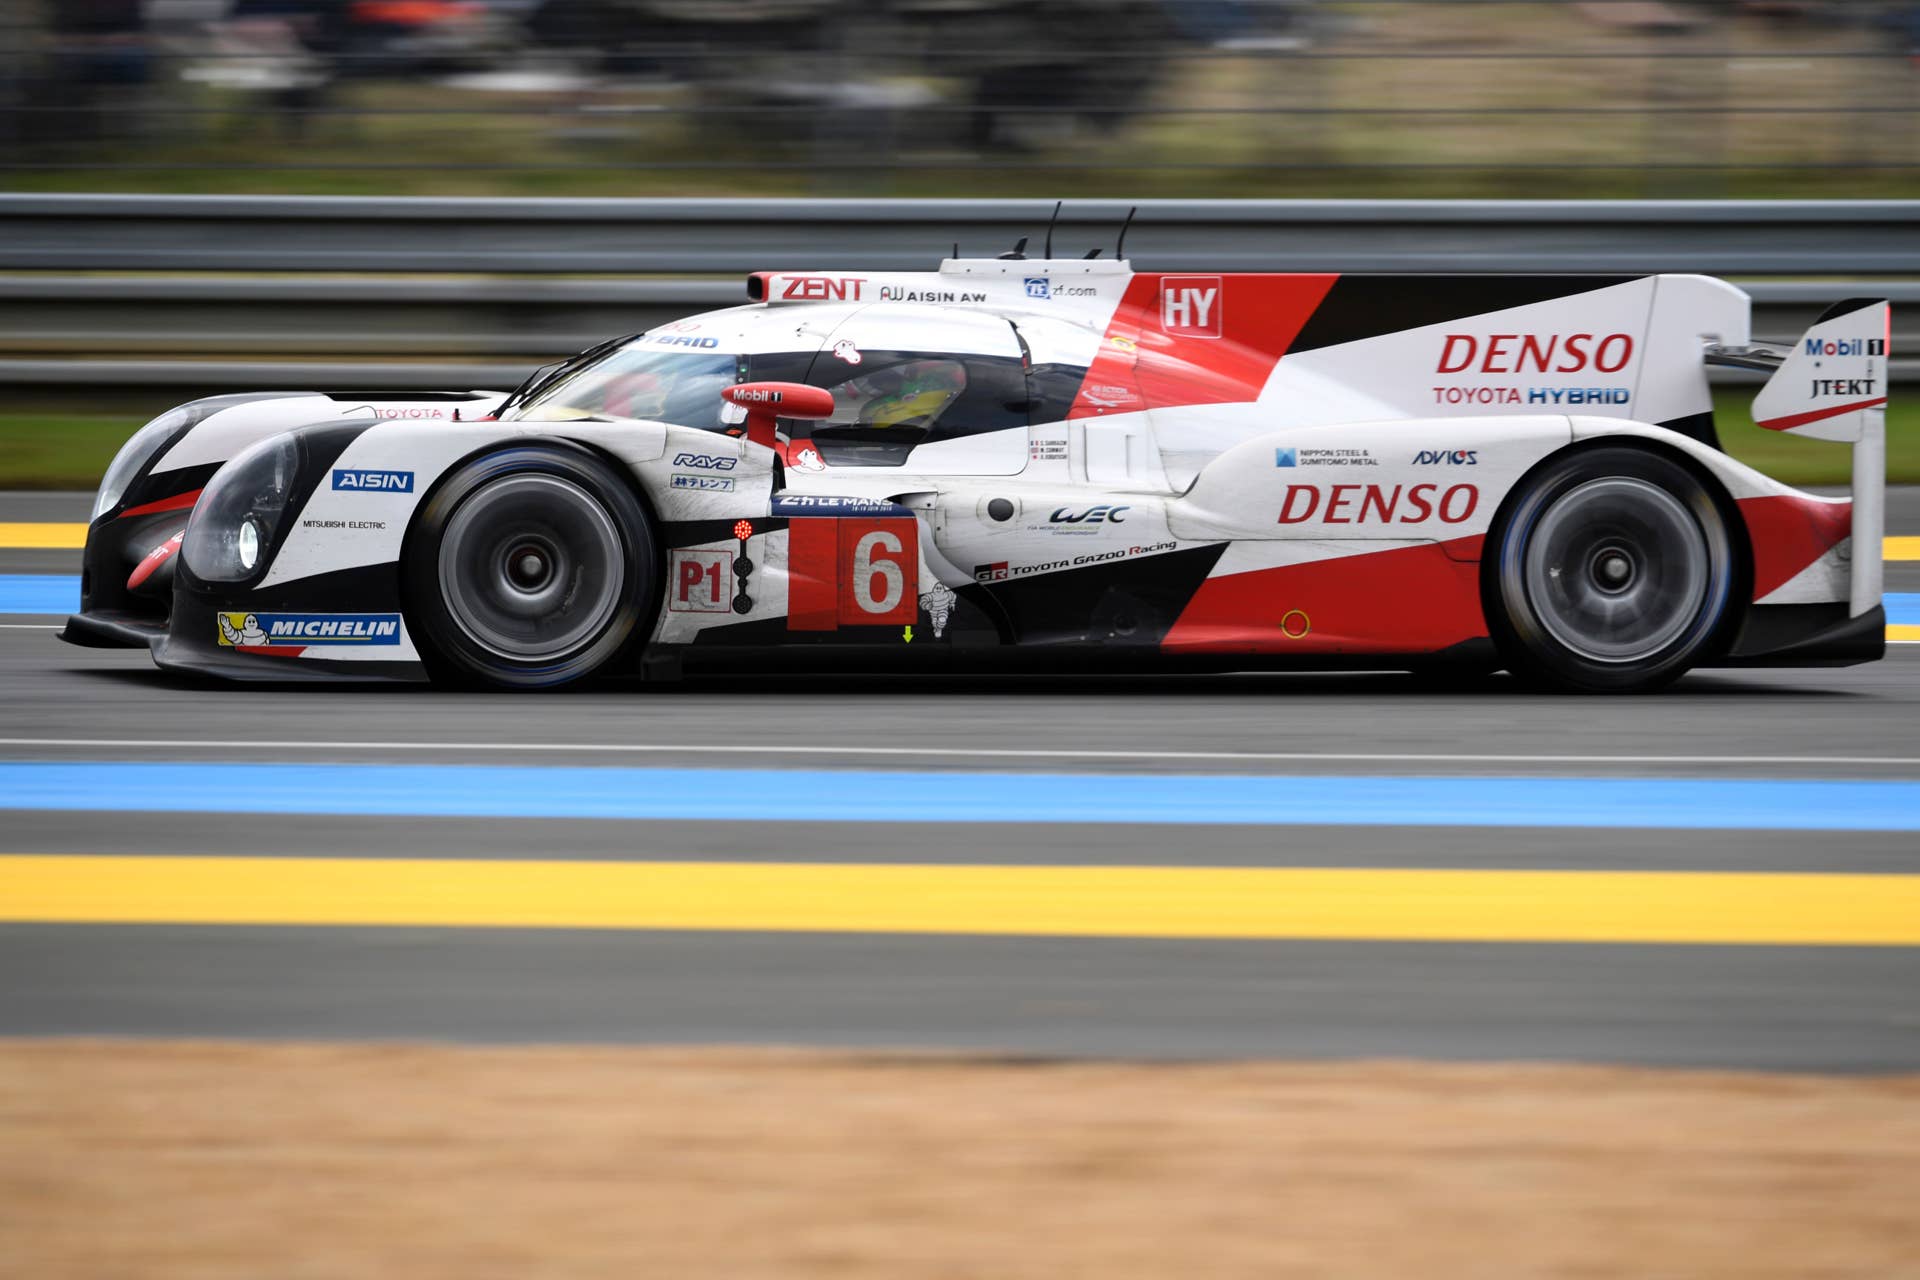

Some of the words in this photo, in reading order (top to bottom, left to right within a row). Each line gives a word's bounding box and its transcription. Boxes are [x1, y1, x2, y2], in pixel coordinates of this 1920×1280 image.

[782, 276, 867, 300] ZENT
[1052, 284, 1097, 297] zf.com
[906, 292, 954, 302] AISIN
[960, 293, 987, 303] AW
[1165, 288, 1217, 327] HY
[1436, 333, 1634, 374] DENSO
[1806, 338, 1862, 356] Mobil
[1869, 339, 1883, 355] 1
[733, 389, 769, 402] Mobil
[1433, 387, 1522, 404] TOYOTA
[1528, 387, 1631, 404] HYBRID
[1810, 379, 1876, 399] JTEKT
[376, 408, 443, 419] TOYOTA
[673, 453, 738, 470] RAYS
[1300, 458, 1348, 466] SUMITOMO
[1350, 458, 1379, 466] METAL
[338, 473, 408, 489] AISIN
[818, 498, 839, 506] LE
[843, 498, 894, 506] MANS
[1277, 483, 1479, 524] DENSO
[1049, 505, 1131, 523] WEC
[303, 520, 346, 529] MITSUBISHI
[348, 521, 386, 530] ELECTRIC
[975, 567, 1008, 581] GR
[1011, 559, 1070, 576] TOYOTA
[1073, 550, 1126, 566] GAZOO
[1129, 541, 1177, 556] Racing
[853, 530, 904, 614] 6
[679, 561, 721, 603] P1
[271, 621, 397, 636] MICHELIN
